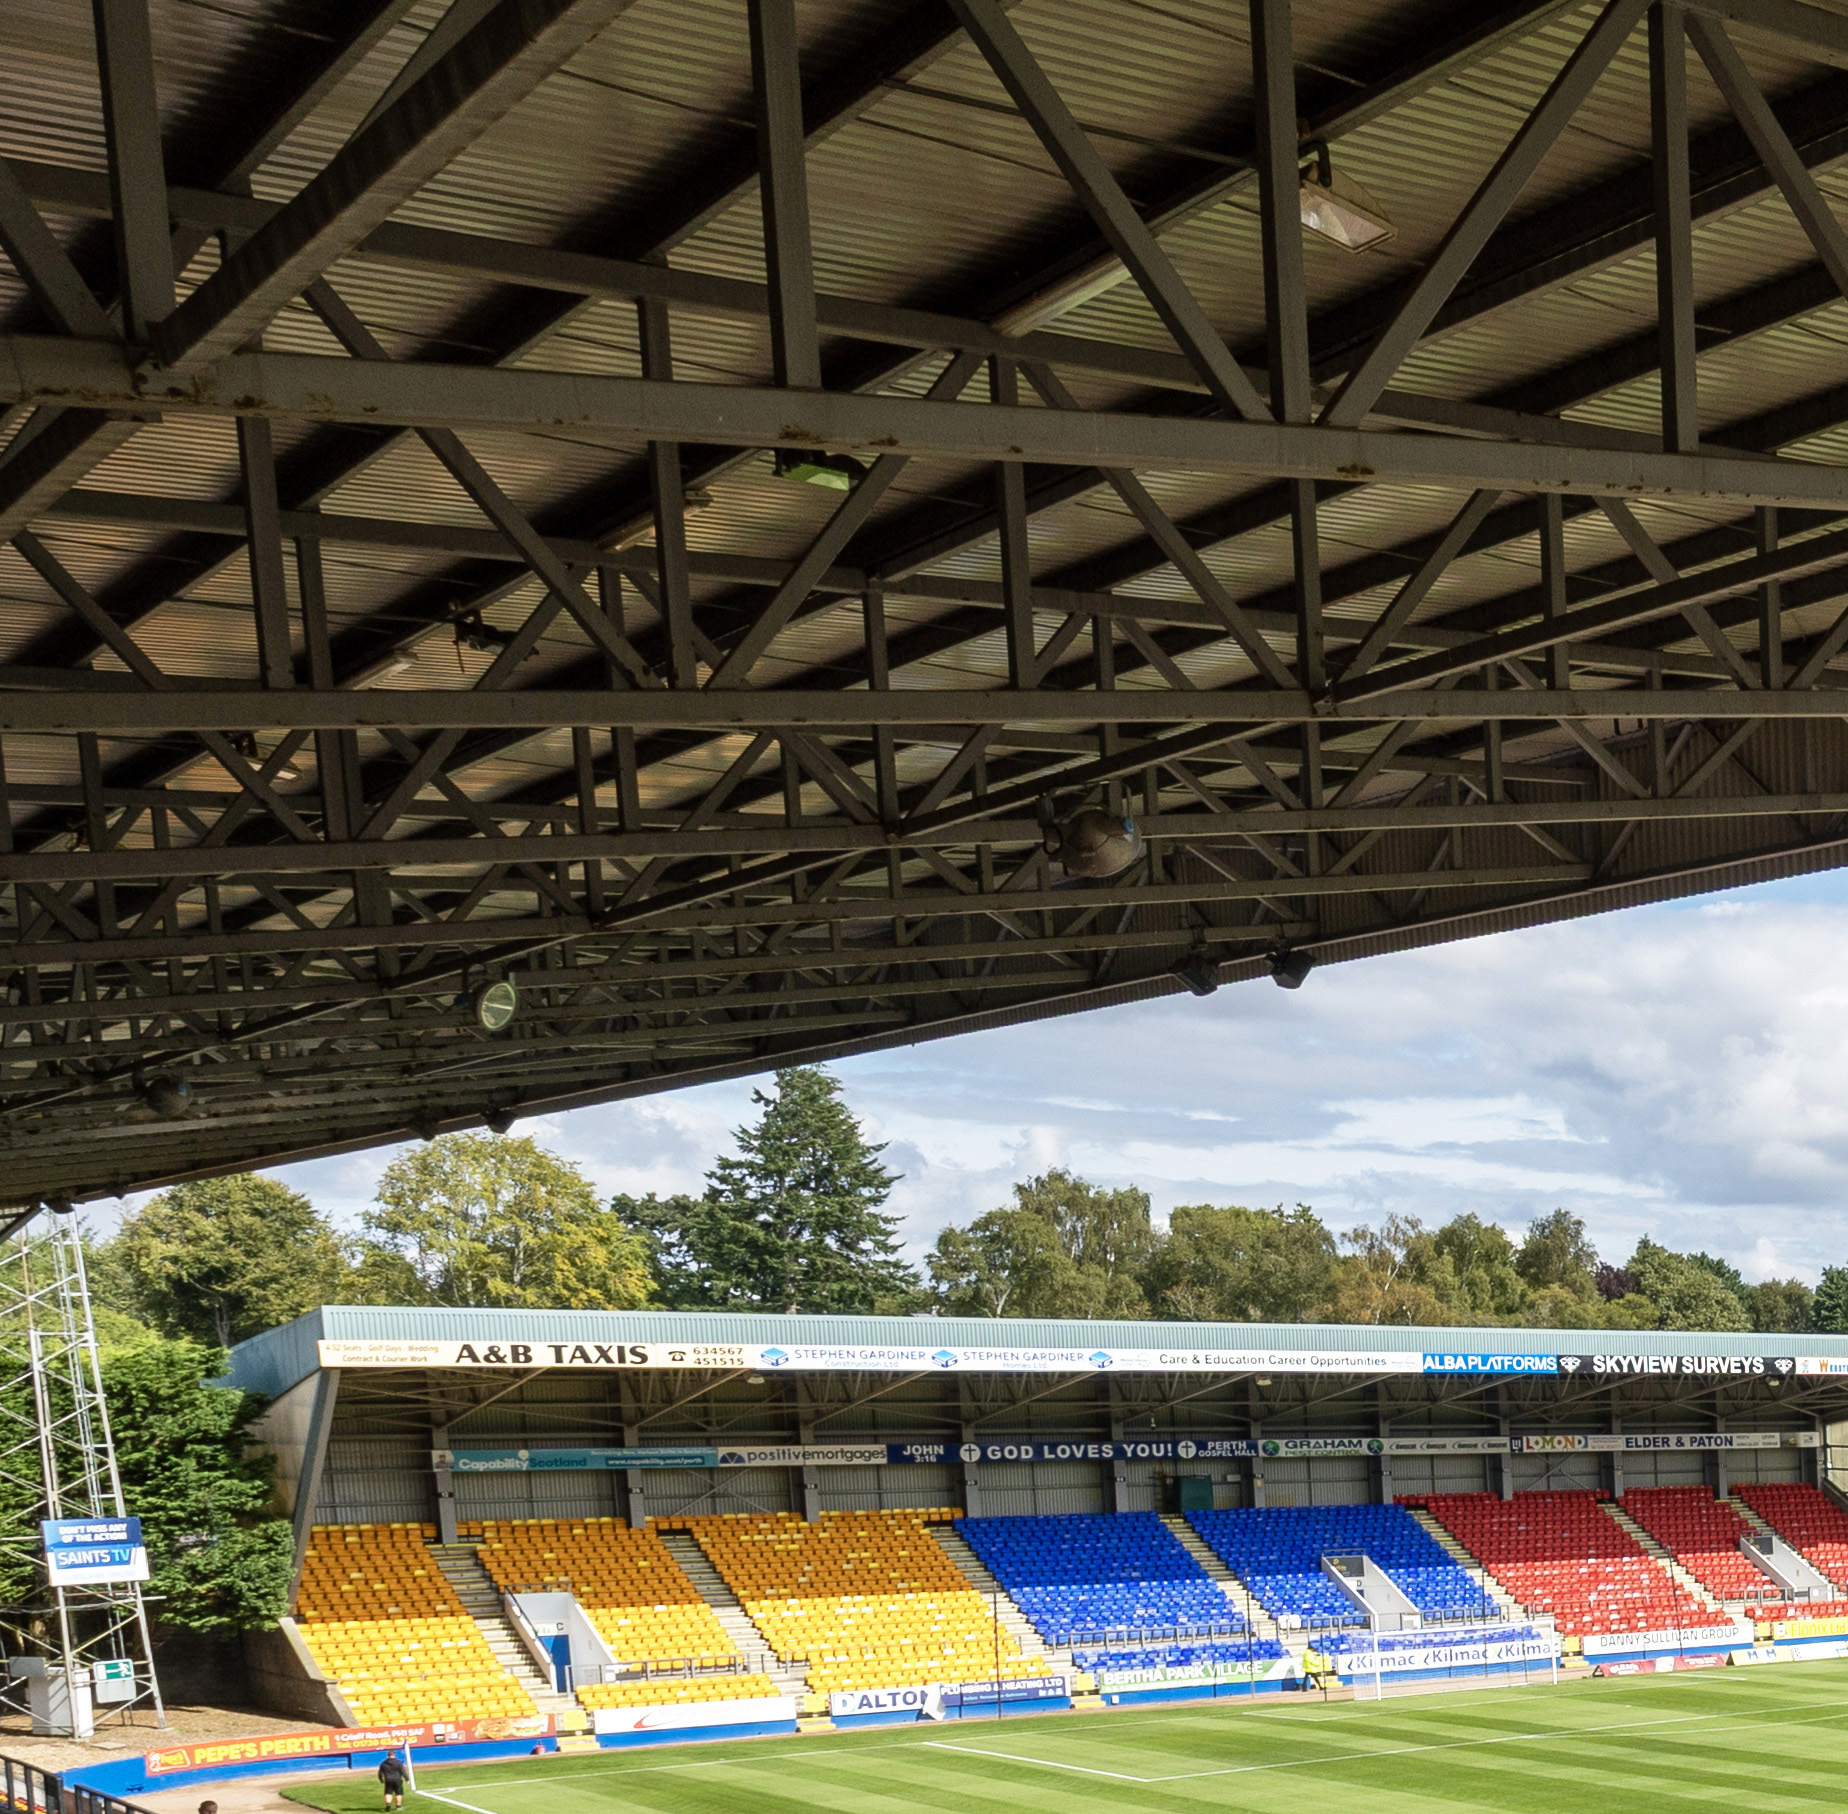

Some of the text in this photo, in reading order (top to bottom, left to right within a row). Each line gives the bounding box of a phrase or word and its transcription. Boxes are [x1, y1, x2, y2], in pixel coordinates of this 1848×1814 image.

[456, 1344, 648, 1365] A&B TAXIS
[693, 1347, 743, 1355] 634567
[694, 1358, 744, 1366] 451515
[1160, 1354, 1387, 1367] Care & Education Career Opportunities
[1593, 1356, 1764, 1374] SKYVIEW SURVEYS
[903, 1445, 944, 1456] JOHN
[1285, 1439, 1363, 1450] GRAHAM
[1526, 1436, 1588, 1450] LOMOND
[986, 1443, 1172, 1459] GOD LOVES YOU!
[459, 1456, 587, 1471] Capability Scotland
[58, 1549, 130, 1566] SAINTS TV
[1791, 1621, 1846, 1636] Flonix Ltd
[1600, 1627, 1739, 1647] DANNY SULLIVAN GROUP
[1103, 1660, 1263, 1685] BERTHA PARK VILLAGE
[195, 1735, 330, 1764] PEPE'S PERTH
